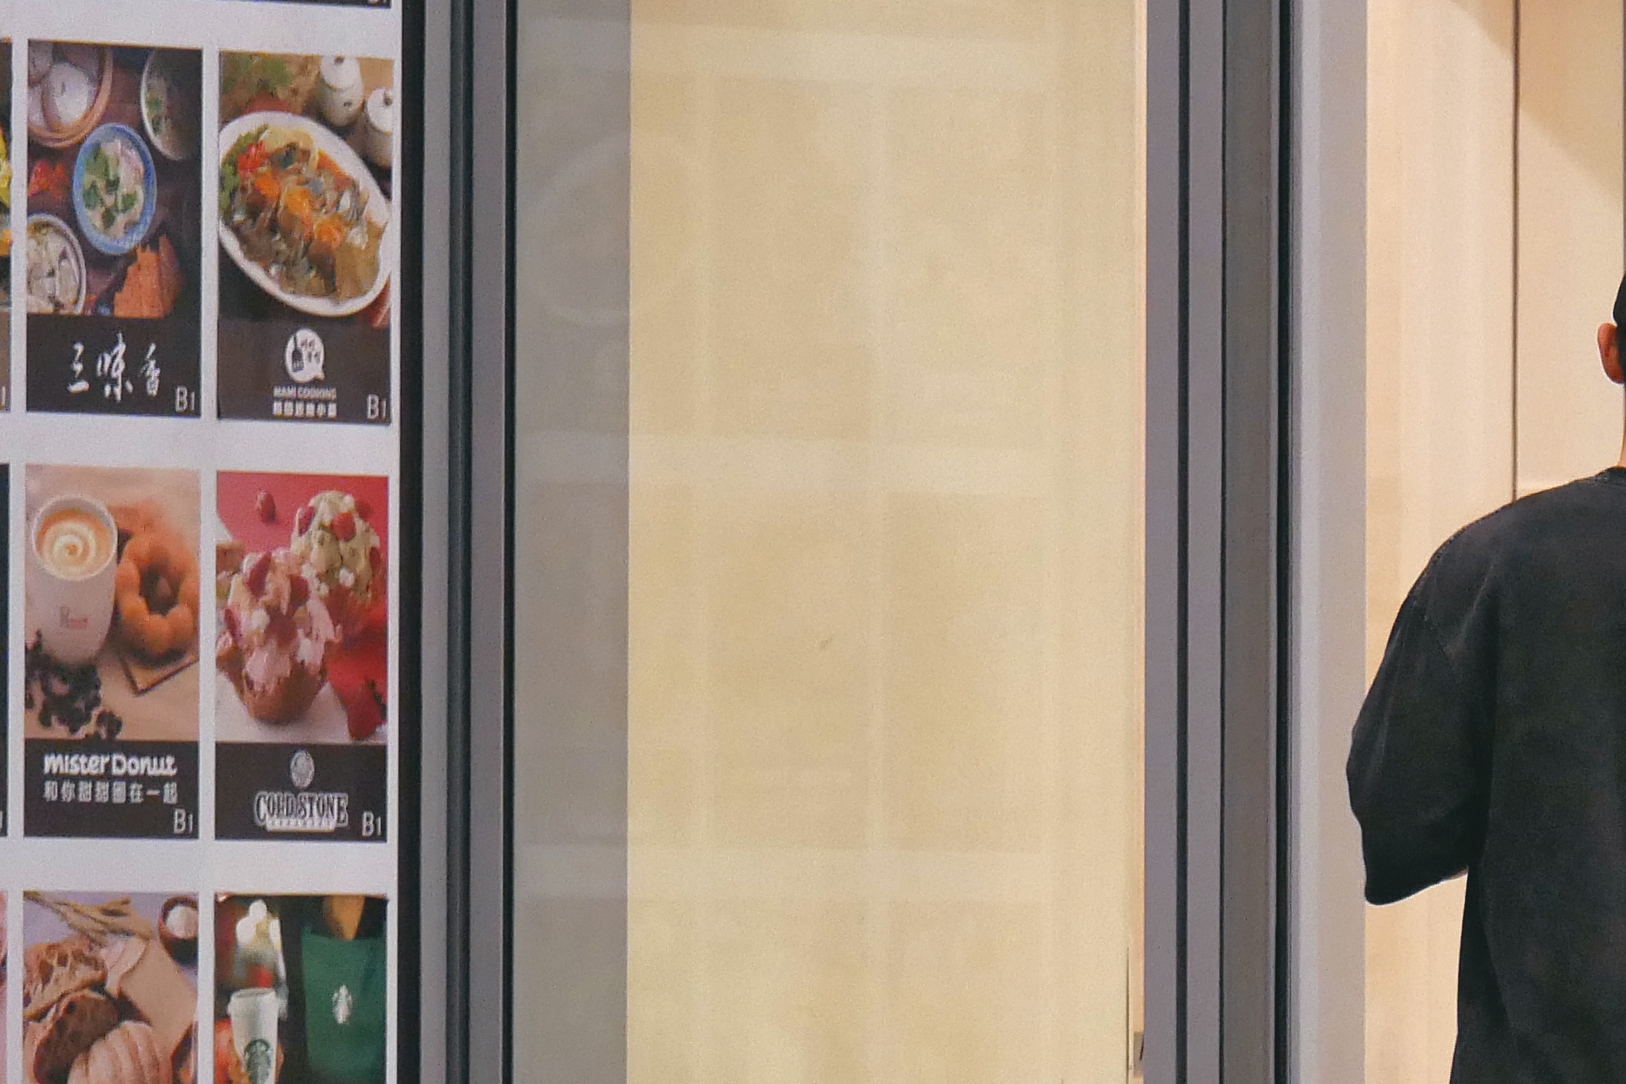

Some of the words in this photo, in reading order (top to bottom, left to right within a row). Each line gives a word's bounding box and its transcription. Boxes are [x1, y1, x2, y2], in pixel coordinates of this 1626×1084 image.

[175, 386, 195, 413] B1
[367, 394, 387, 419] B1
[111, 753, 178, 776] Donut
[173, 808, 193, 834] B1
[362, 812, 382, 837] B1
